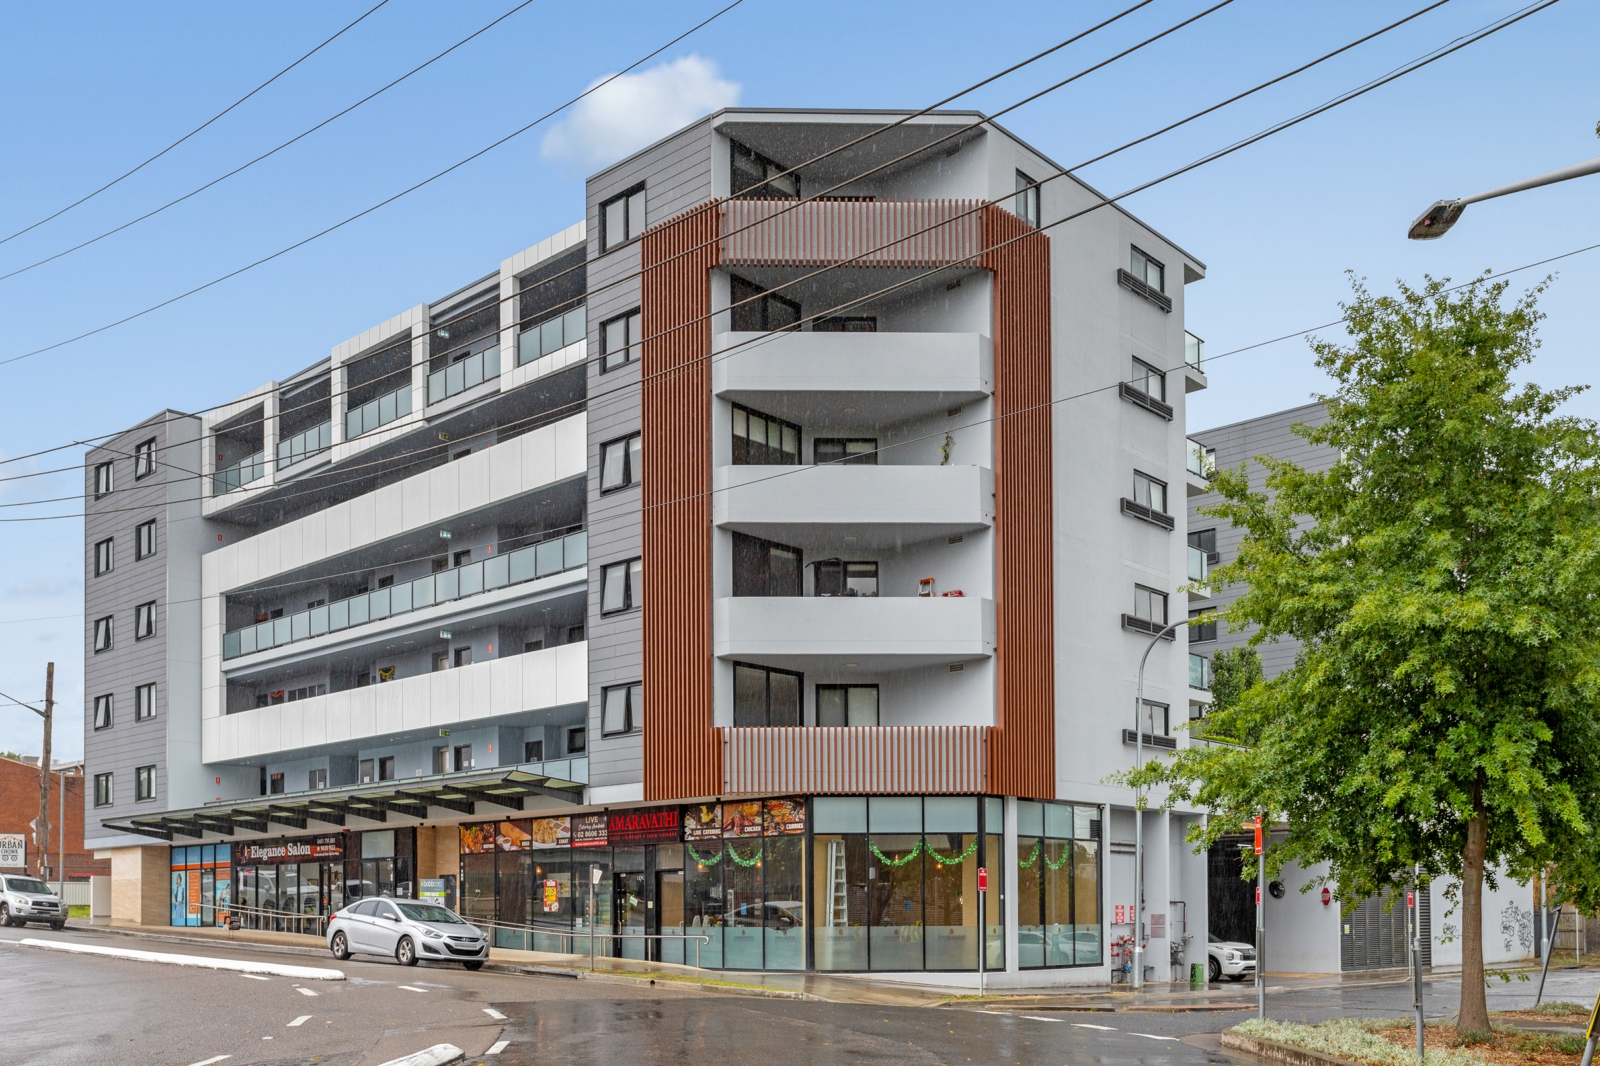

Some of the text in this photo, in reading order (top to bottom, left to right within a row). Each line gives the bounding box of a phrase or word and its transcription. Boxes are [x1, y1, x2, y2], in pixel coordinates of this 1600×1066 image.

[609, 812, 678, 830] AMARAVATHI
[251, 846, 285, 860] Elegance
[287, 843, 310, 855] Salon
